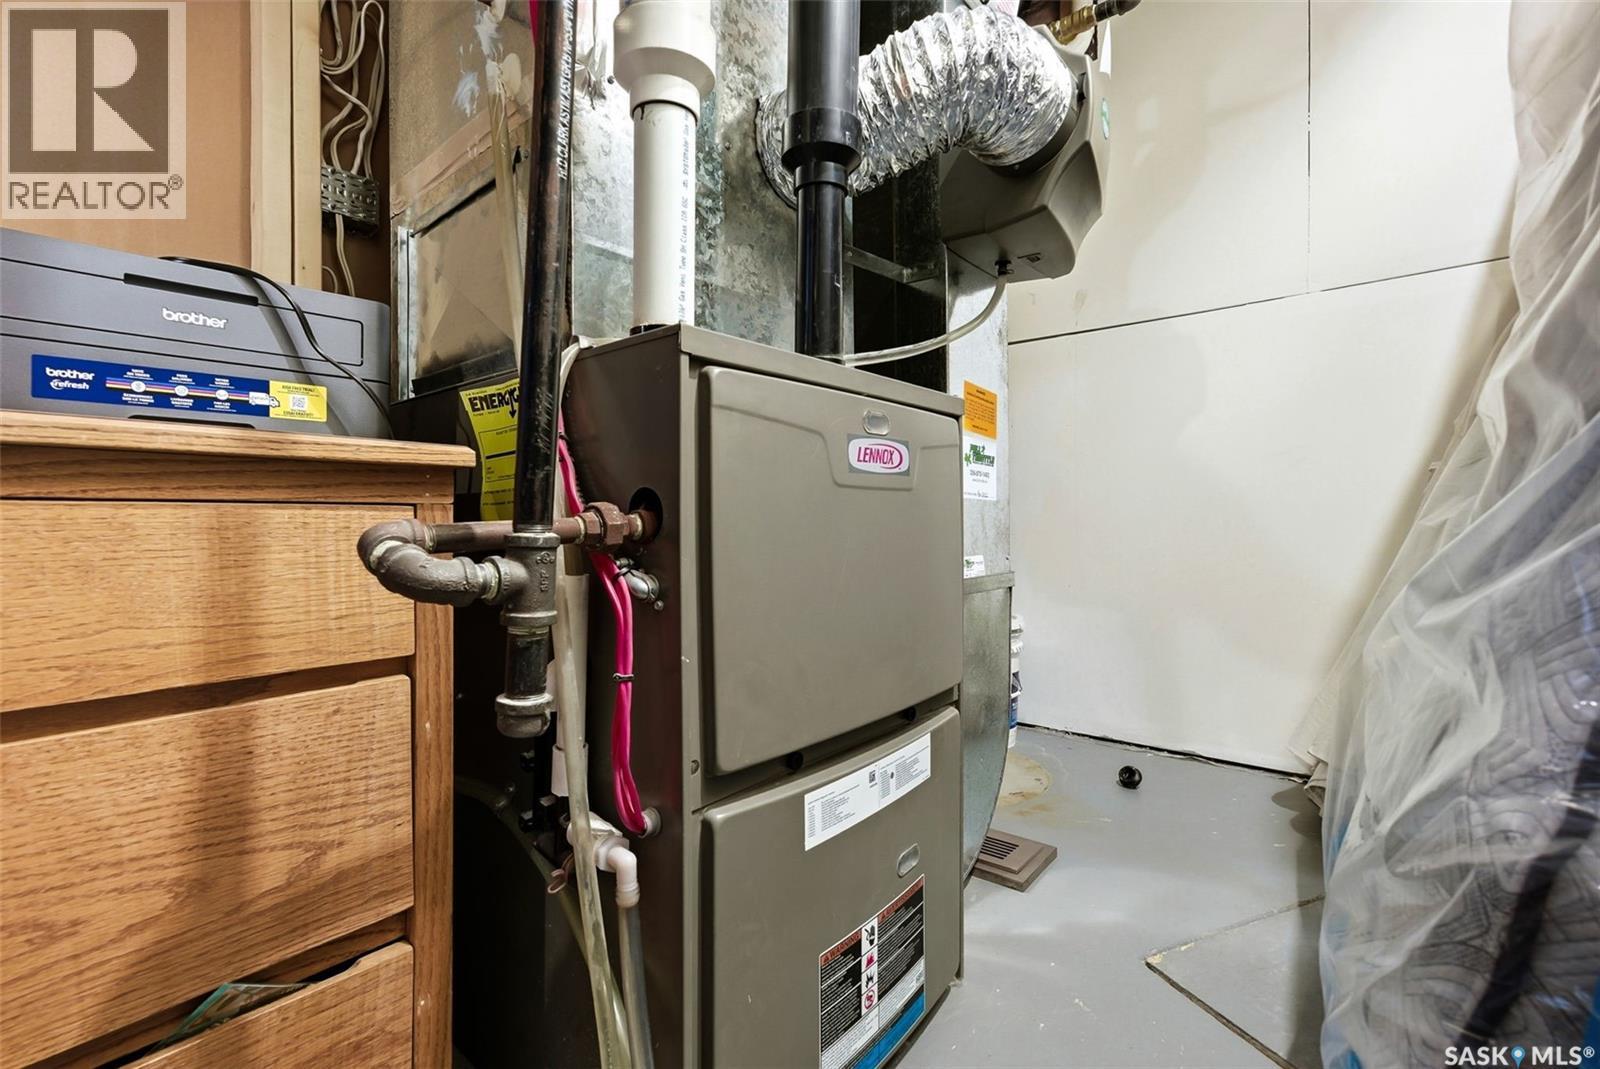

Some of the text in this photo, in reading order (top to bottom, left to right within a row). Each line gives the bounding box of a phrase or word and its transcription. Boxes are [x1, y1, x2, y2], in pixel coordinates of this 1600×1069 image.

[556, 123, 569, 158] CLARK
[162, 307, 228, 329] brother
[45, 366, 95, 381] brother
[50, 379, 90, 391] refresh
[857, 446, 895, 465] LENNOX
